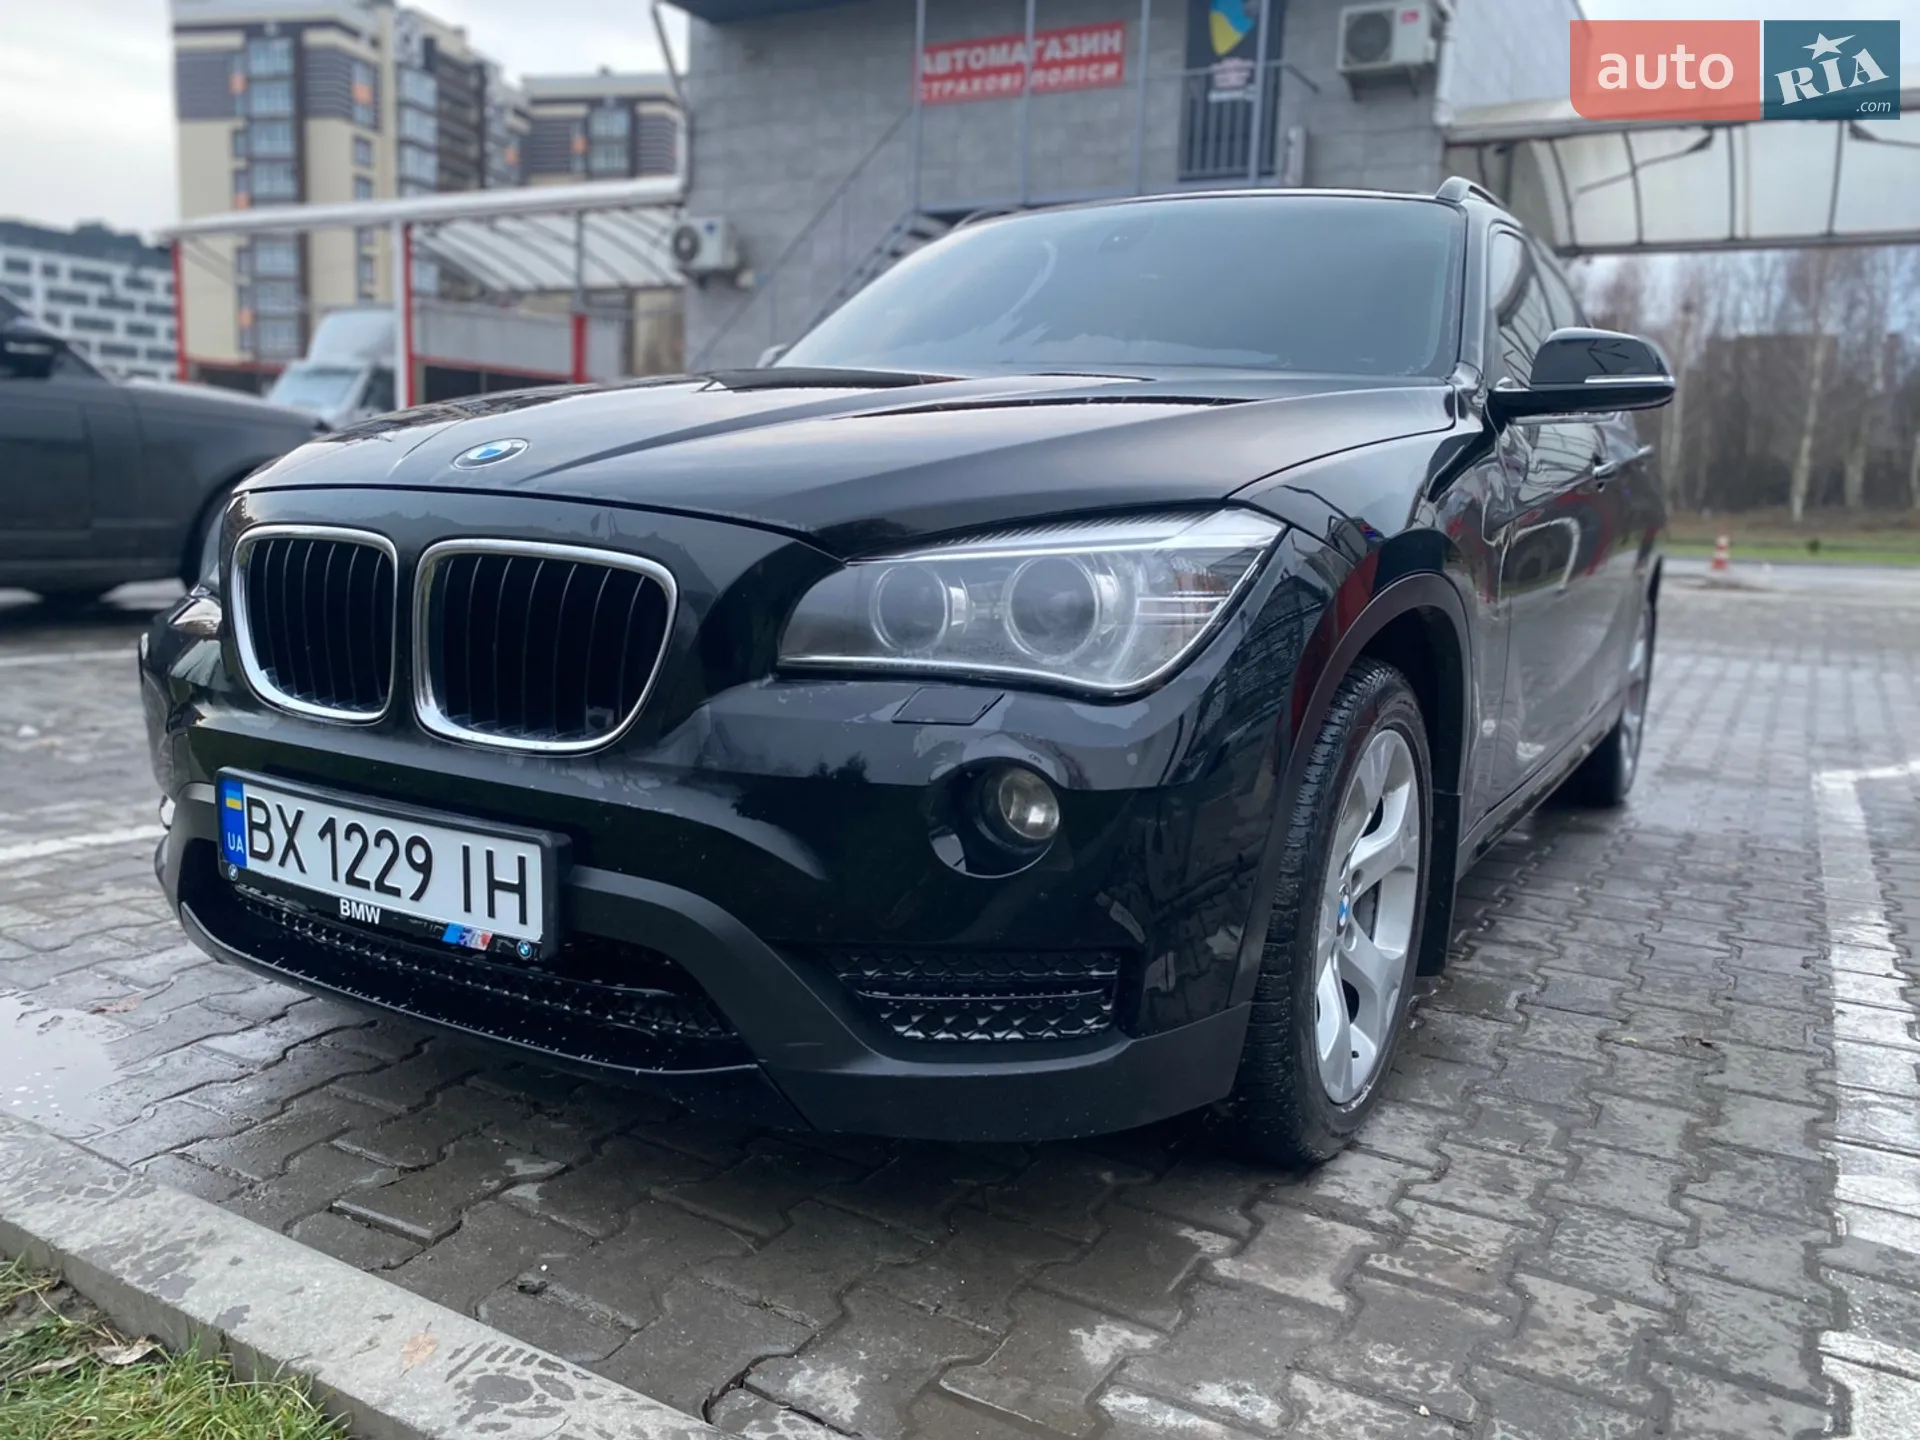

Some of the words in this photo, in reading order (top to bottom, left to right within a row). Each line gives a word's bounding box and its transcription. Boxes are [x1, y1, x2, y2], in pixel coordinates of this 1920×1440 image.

[227, 833, 245, 854] UA
[317, 817, 434, 902] 1229
[339, 899, 381, 924] BMW
